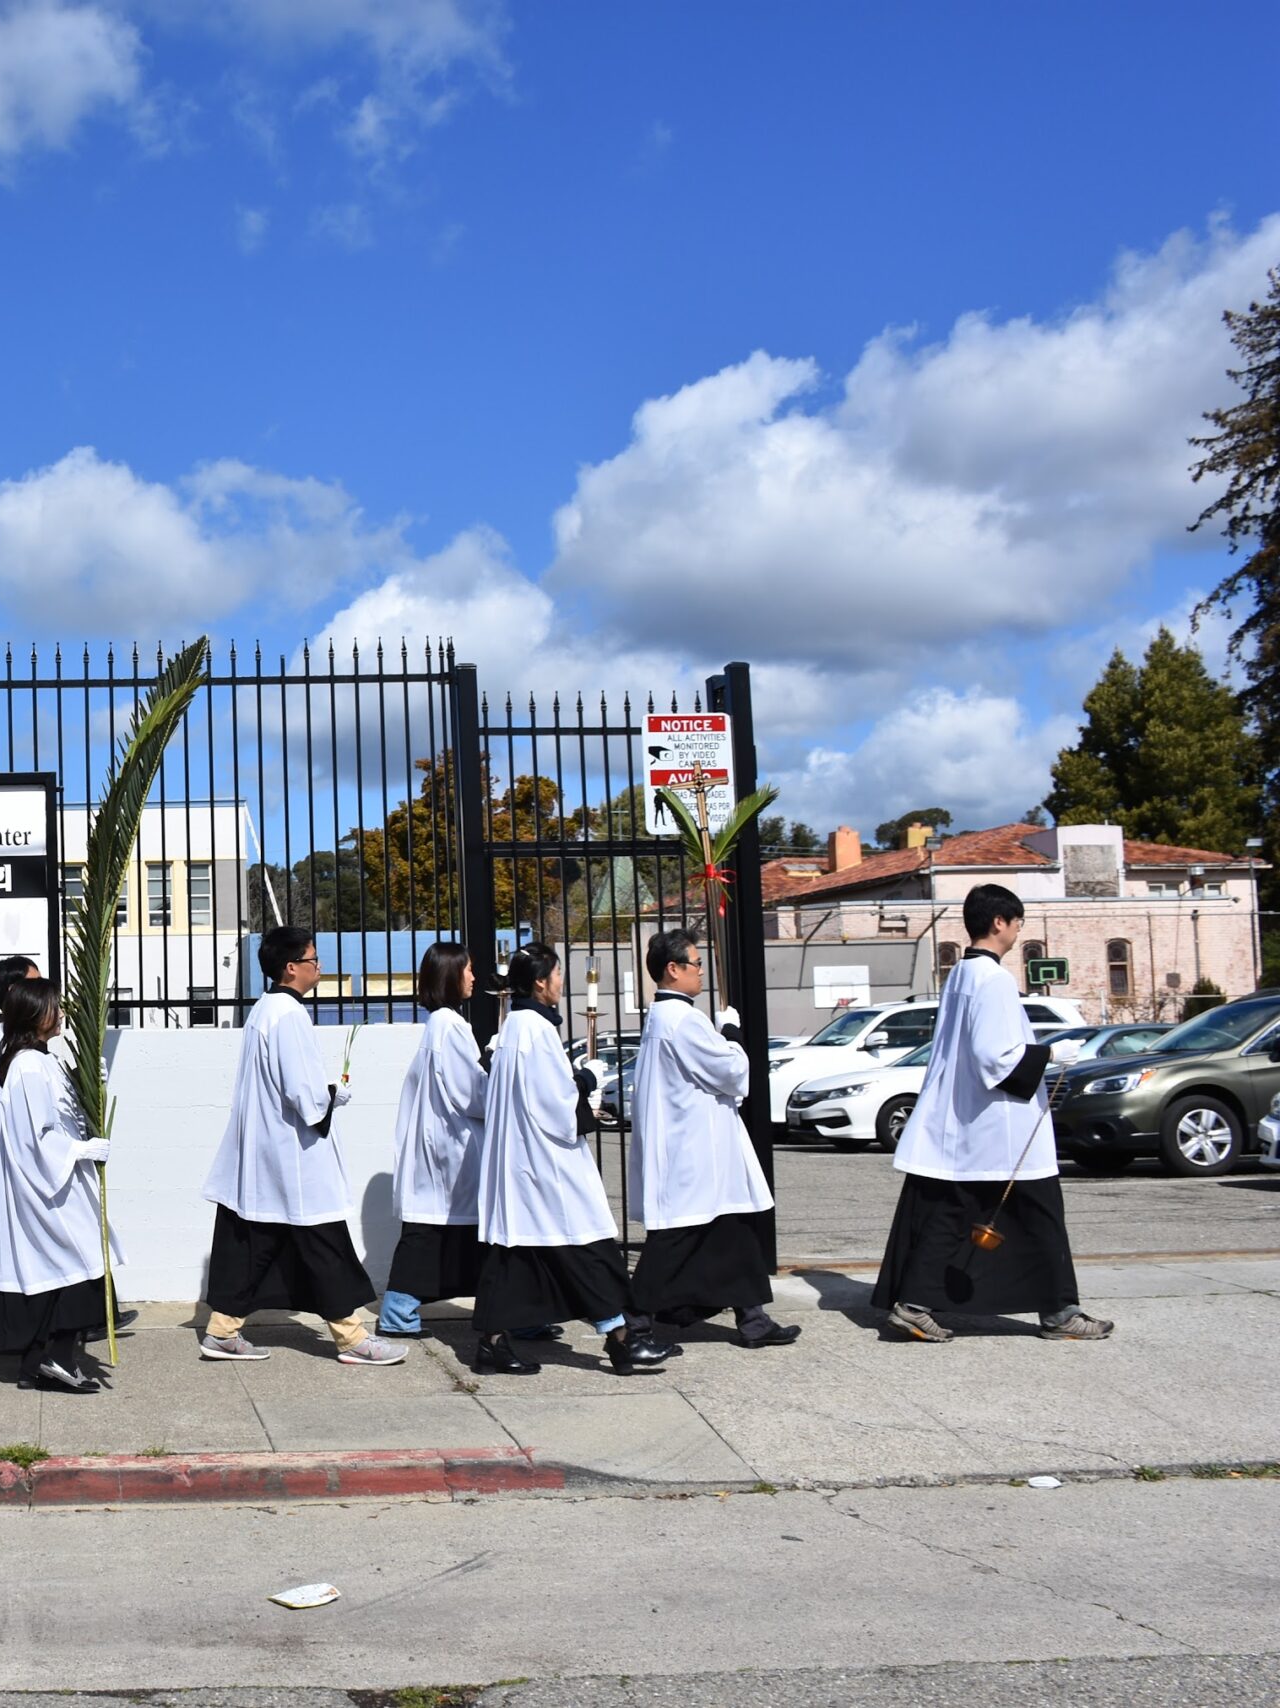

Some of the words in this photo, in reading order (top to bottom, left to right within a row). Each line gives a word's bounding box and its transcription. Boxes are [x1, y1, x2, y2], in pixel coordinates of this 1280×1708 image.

[661, 720, 713, 731] NOTICE
[685, 733, 726, 741] ACTIVITIES
[674, 742, 719, 750] MONITORED
[692, 751, 716, 759] VIDEO
[679, 760, 717, 768] CAMRAS
